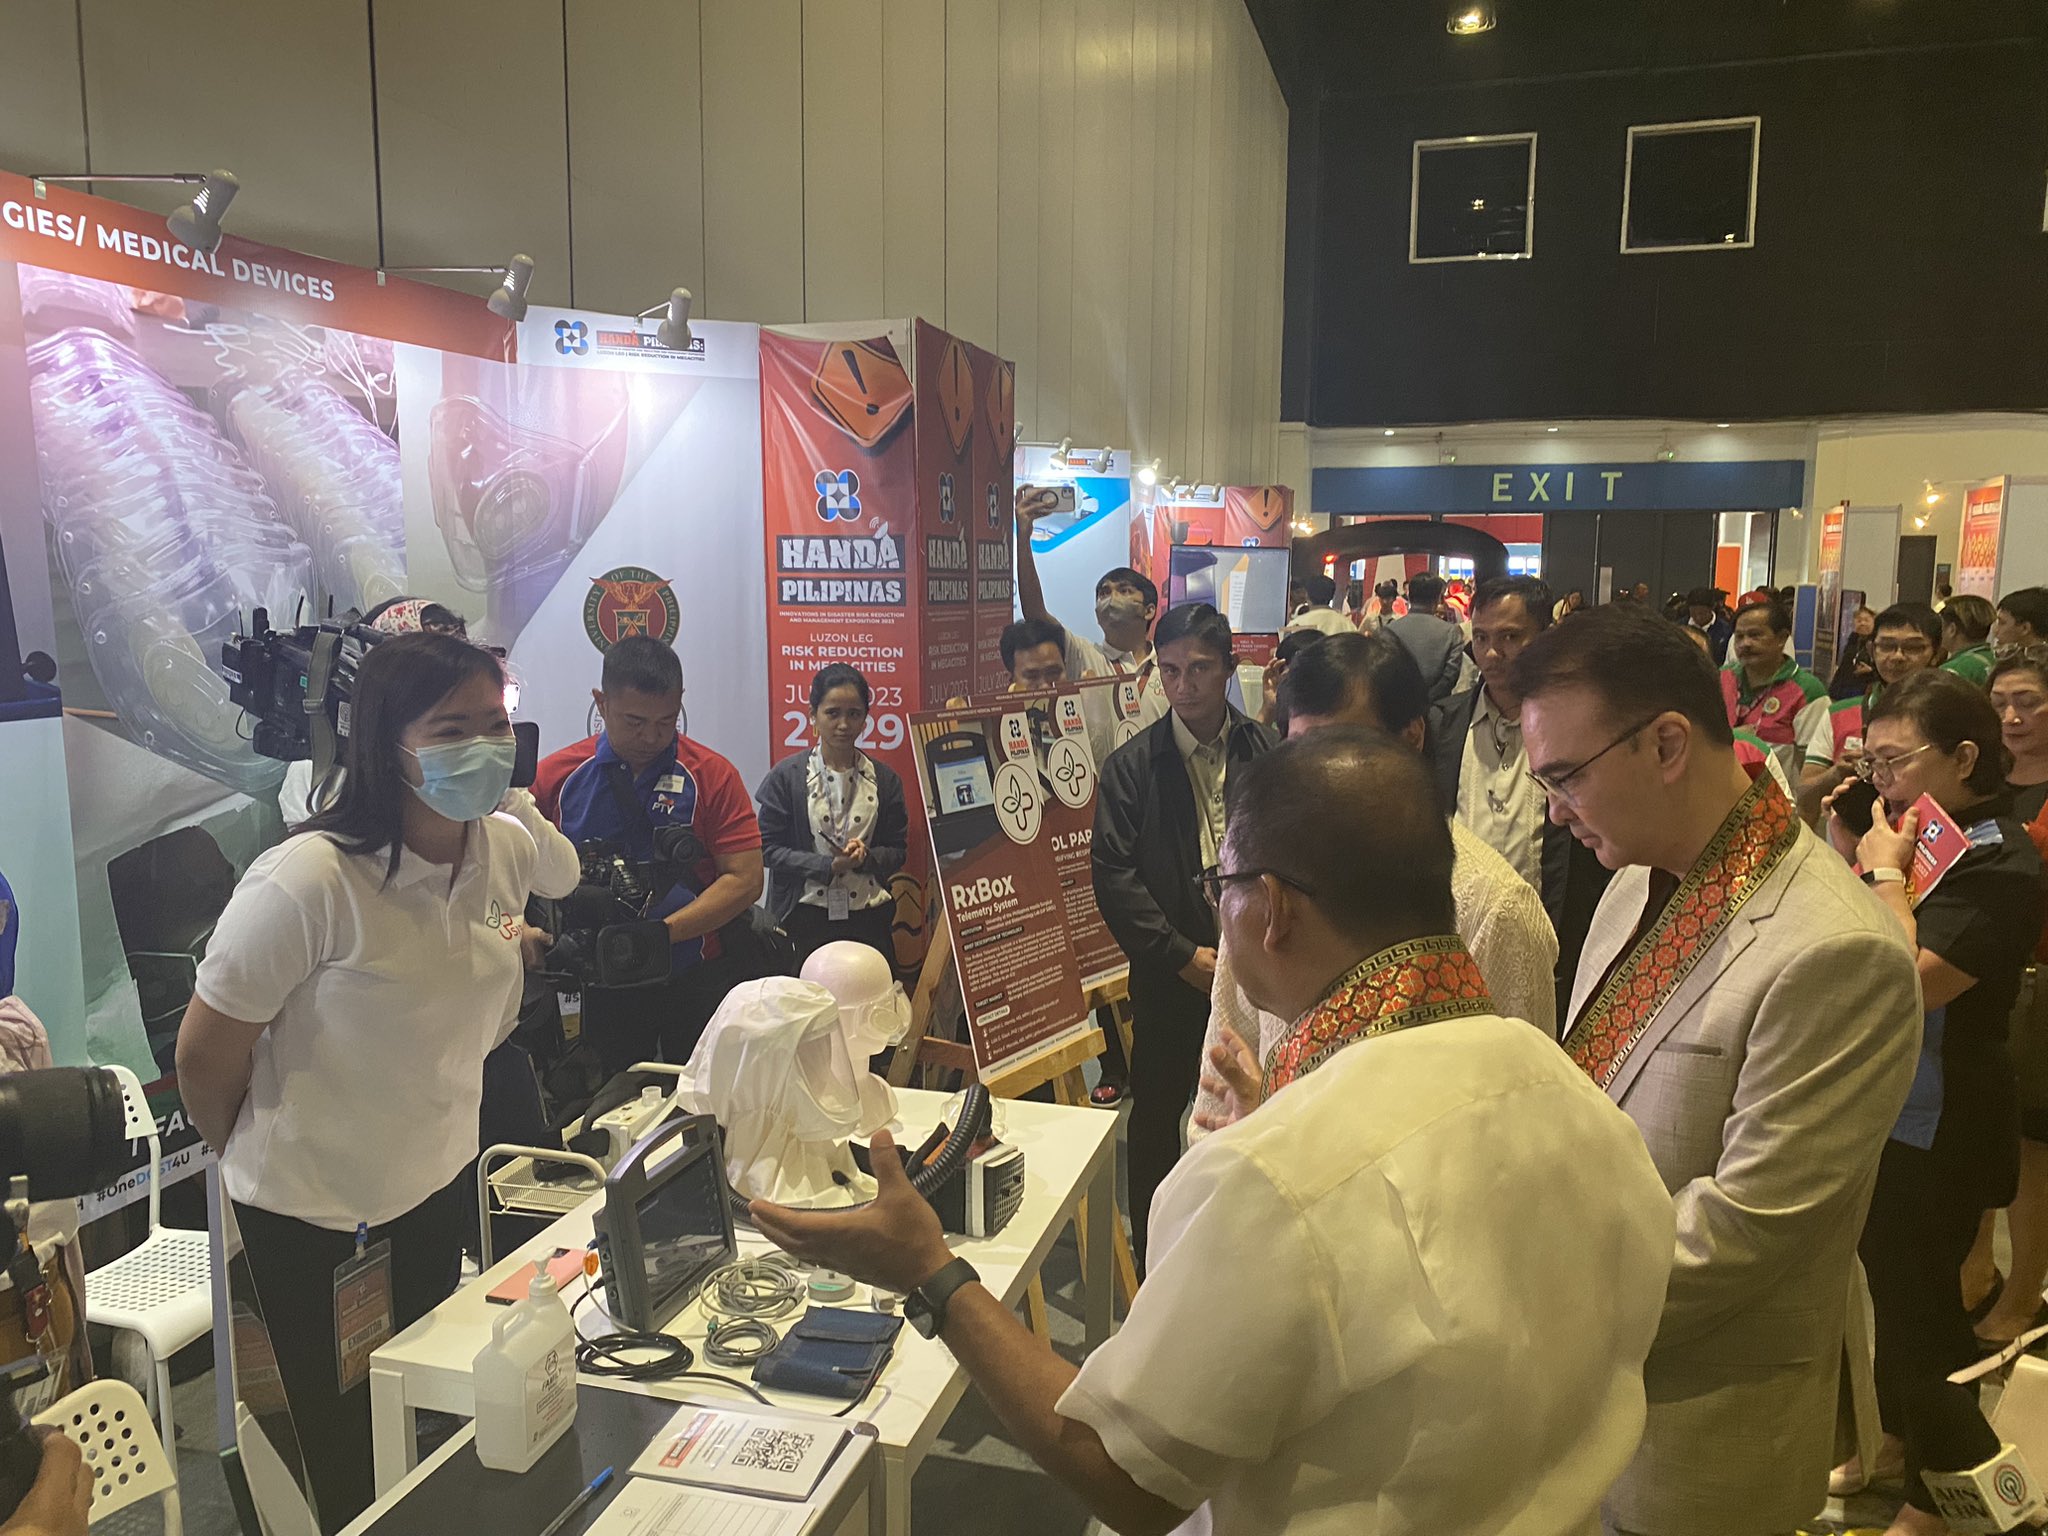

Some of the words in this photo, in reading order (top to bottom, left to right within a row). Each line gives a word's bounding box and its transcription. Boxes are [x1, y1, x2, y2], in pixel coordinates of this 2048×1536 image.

[2, 201, 86, 247] GIES/
[96, 224, 225, 278] MEDICAL
[232, 258, 335, 302] DEVICES
[1492, 472, 1622, 502] EXIT
[782, 537, 900, 570] HANDA
[611, 570, 625, 581] OF
[782, 580, 901, 603] PILIPINAS
[928, 580, 968, 601] PILIPINAS
[978, 580, 1010, 600] PILIPINAS
[810, 633, 849, 643] LUZON
[852, 634, 873, 643] LEG
[781, 645, 814, 657] RISK
[818, 646, 903, 658] REDUCTION
[790, 660, 804, 671] IN
[785, 684, 812, 704] JU
[951, 875, 1016, 910] RxBox
[957, 906, 993, 923] Telemetry
[993, 898, 1018, 913] System
